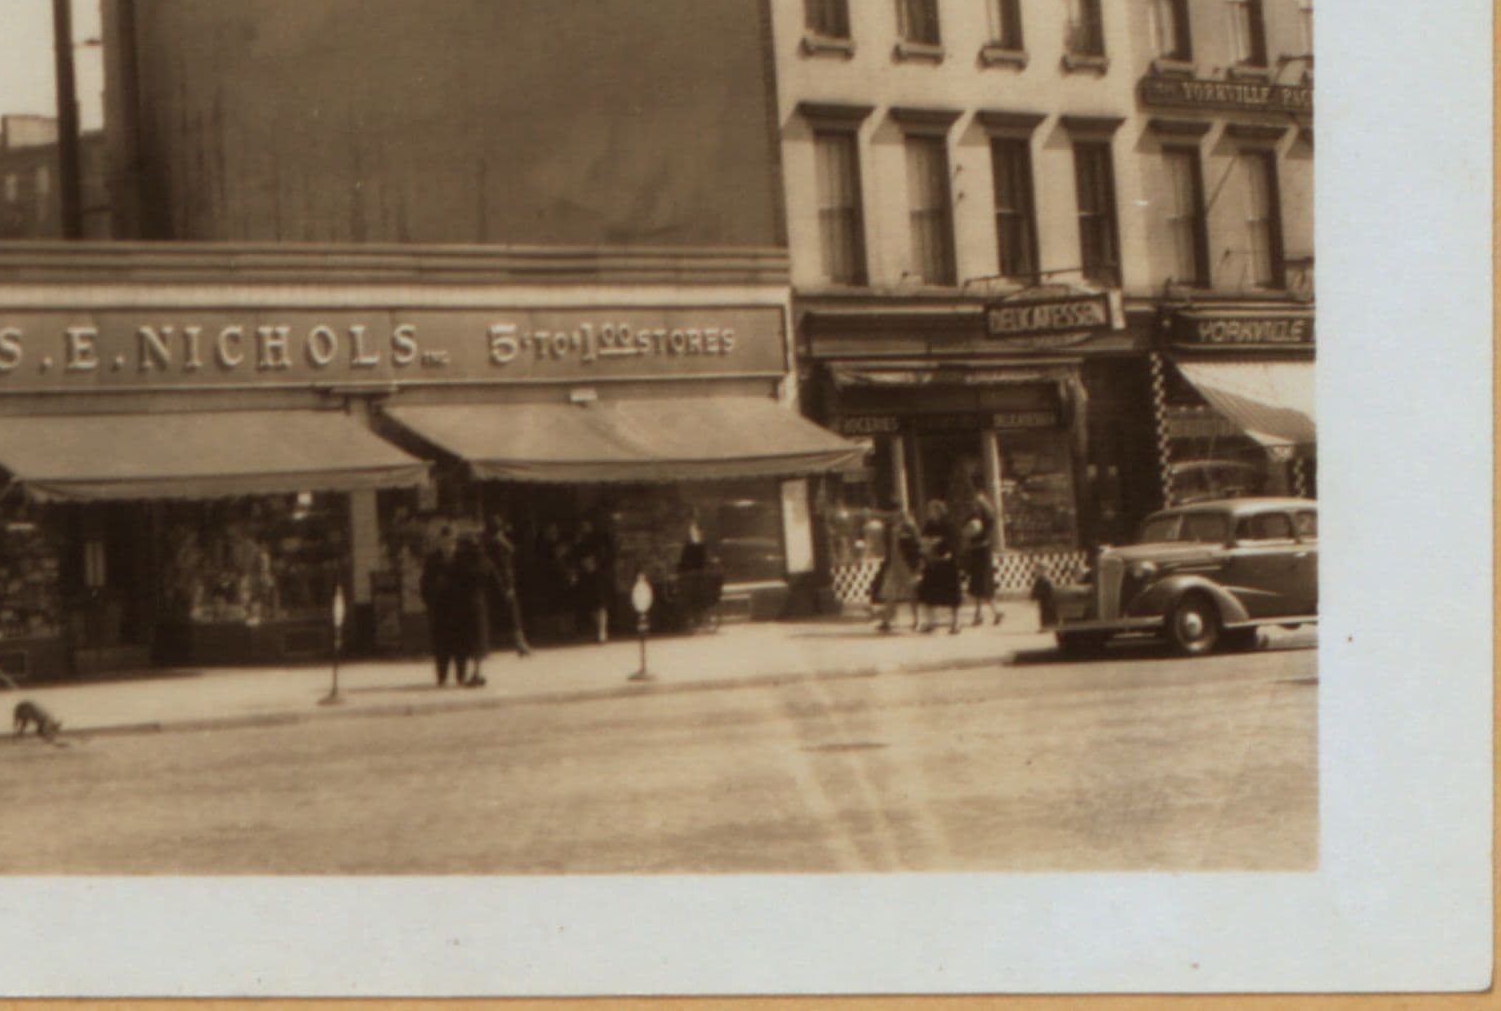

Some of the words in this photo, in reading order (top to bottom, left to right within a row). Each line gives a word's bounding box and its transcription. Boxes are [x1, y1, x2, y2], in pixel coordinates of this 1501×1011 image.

[1181, 80, 1270, 104] YORKVILLE
[988, 300, 1107, 335] DELICATESSEN
[1198, 320, 1305, 343] YORKVILLE
[138, 322, 419, 371] NICHOLS
[635, 326, 737, 356] STORES
